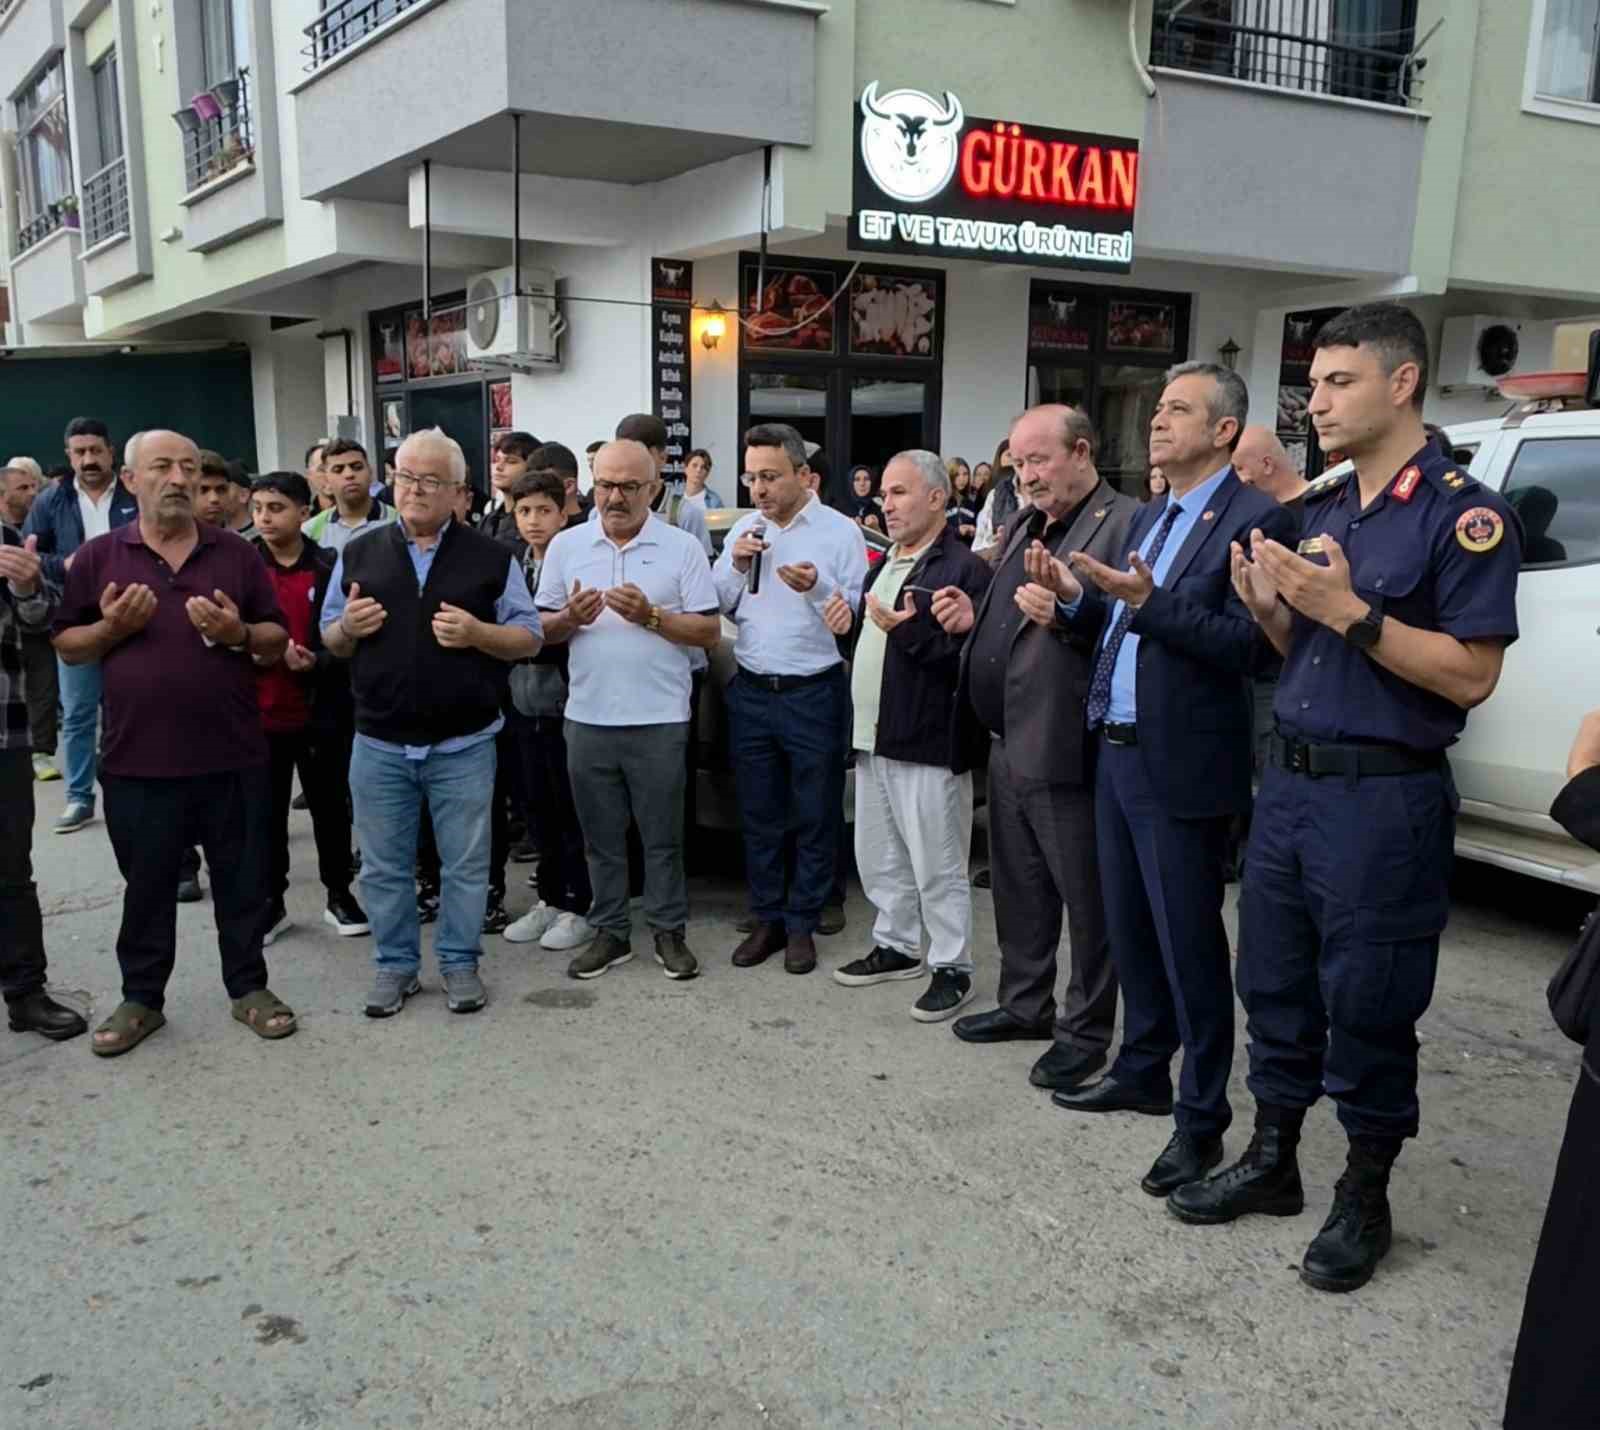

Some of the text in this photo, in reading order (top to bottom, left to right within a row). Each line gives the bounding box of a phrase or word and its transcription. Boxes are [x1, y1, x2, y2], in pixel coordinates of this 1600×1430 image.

[961, 122, 1138, 208] GÜRKAN
[860, 210, 1132, 262] ET VE TAVUK ÜRÜNLERİ
